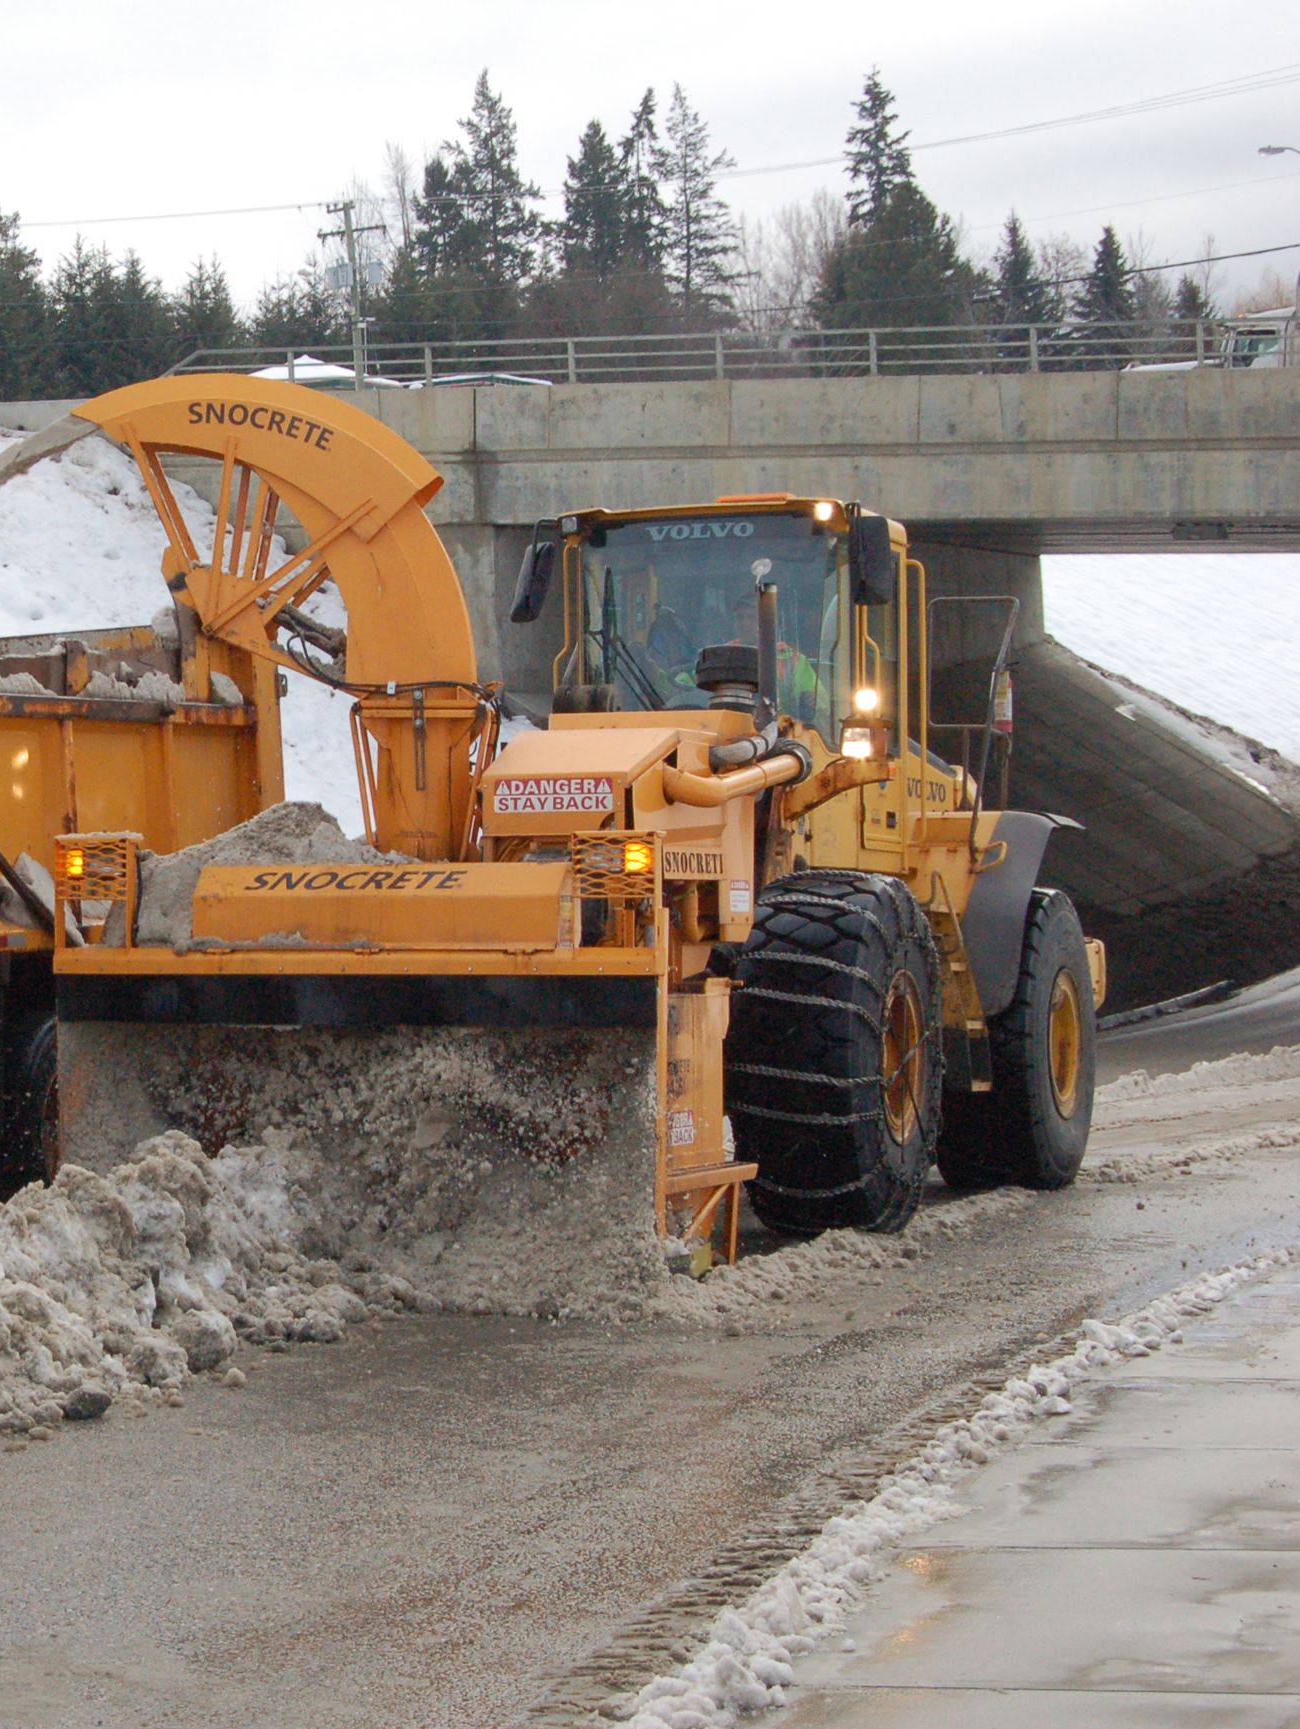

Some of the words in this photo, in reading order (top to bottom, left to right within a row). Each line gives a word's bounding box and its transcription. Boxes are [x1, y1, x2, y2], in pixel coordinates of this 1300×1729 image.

[188, 402, 334, 451] SNOCRETE
[645, 522, 754, 541] VOLVO
[510, 779, 596, 795] DANGER
[498, 796, 550, 811] STAY
[552, 795, 608, 811] BACK
[244, 870, 468, 891] SNOCRETE
